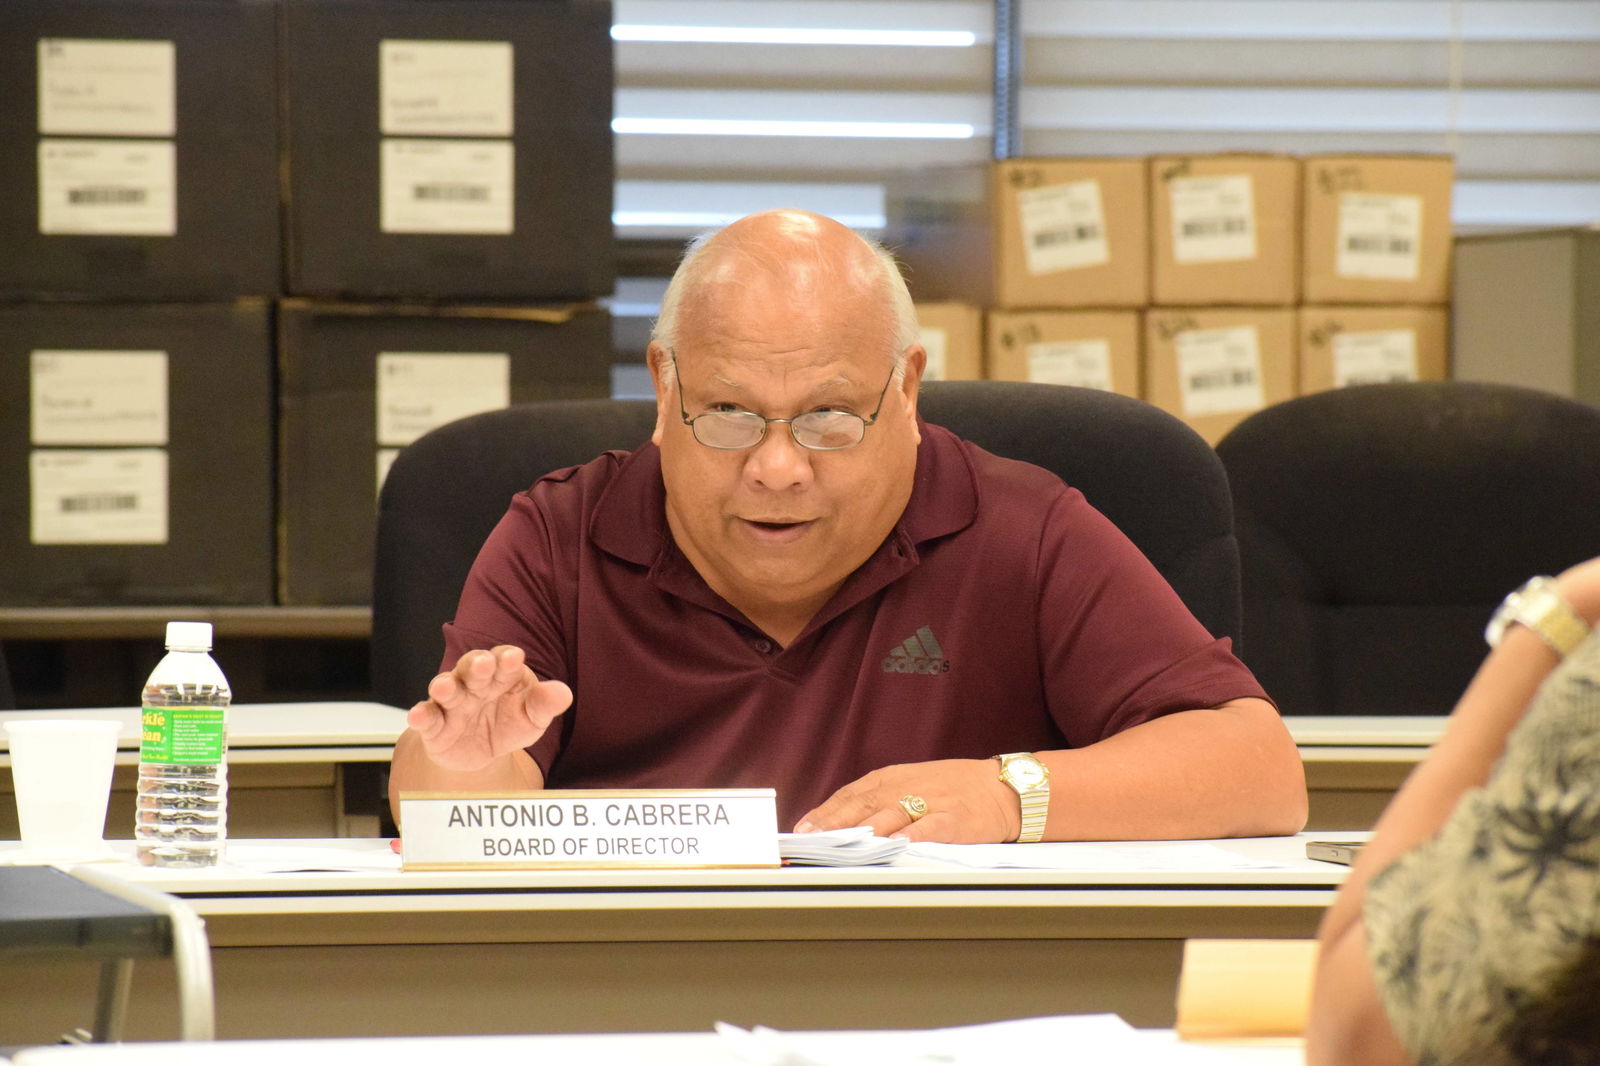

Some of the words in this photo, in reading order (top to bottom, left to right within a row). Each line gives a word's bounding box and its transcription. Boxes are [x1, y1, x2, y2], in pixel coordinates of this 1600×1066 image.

[448, 804, 564, 828] ANTONIO
[573, 804, 597, 827] B.
[605, 803, 731, 826] CABRERA
[483, 838, 556, 856] BOARD
[563, 837, 590, 856] OF
[596, 837, 699, 855] DIRECTOR
